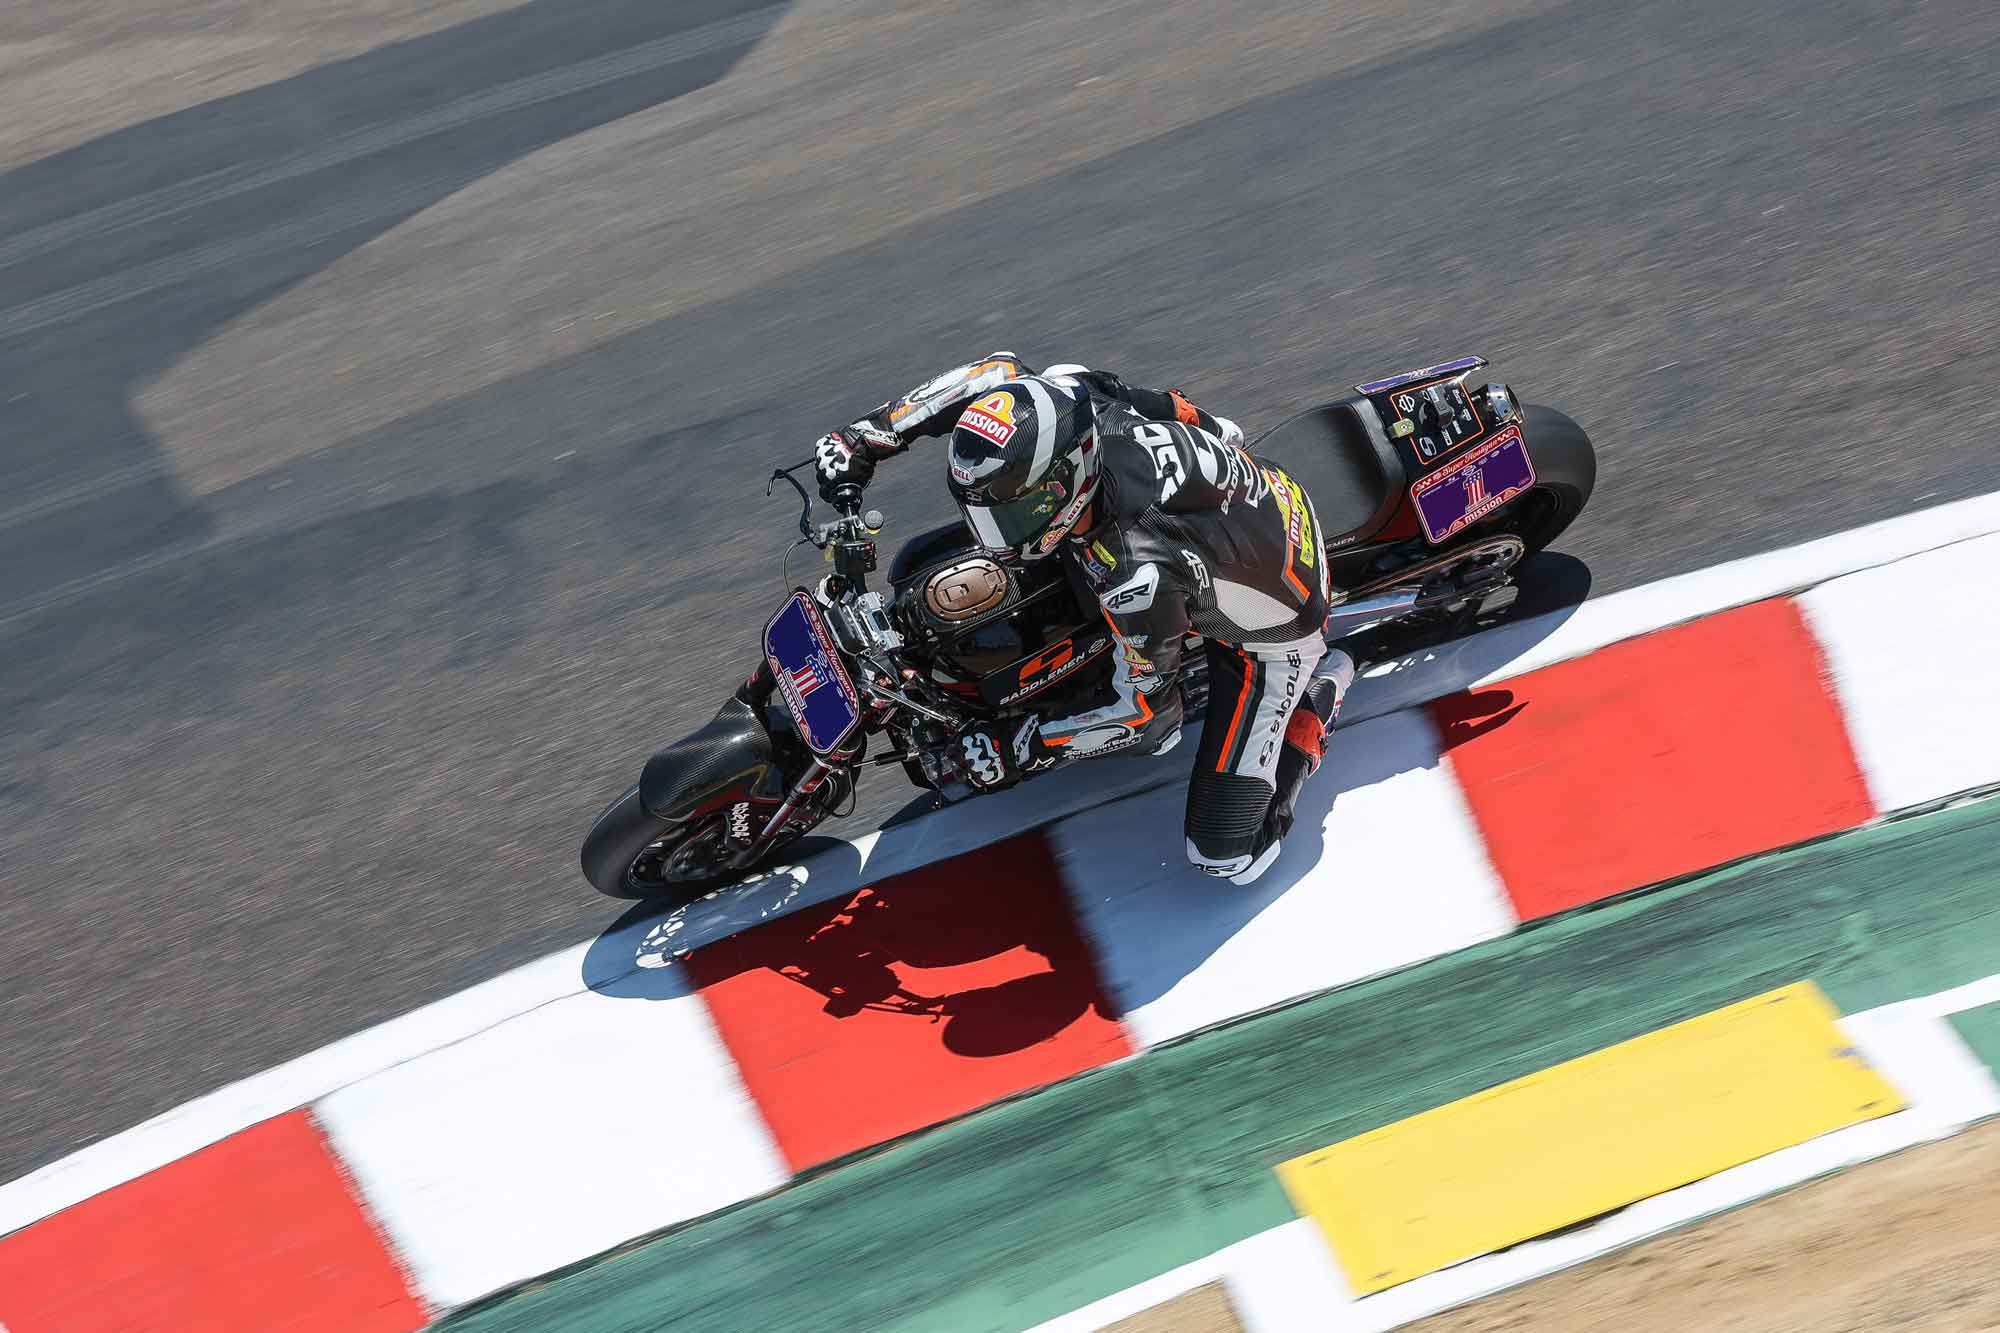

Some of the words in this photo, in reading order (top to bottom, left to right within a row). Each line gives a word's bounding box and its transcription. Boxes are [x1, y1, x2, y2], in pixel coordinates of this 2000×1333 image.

[960, 409, 1010, 439] mission
[952, 468, 972, 482] BELL
[1067, 495, 1085, 521] BELL
[1465, 495, 1503, 524] mission
[1181, 549, 1210, 594] 4SR
[1107, 583, 1151, 609] 4SR
[814, 622, 829, 649] Super
[827, 648, 851, 693] Hooligan
[999, 653, 1085, 705] SADDLEMEN
[777, 673, 802, 724] mission
